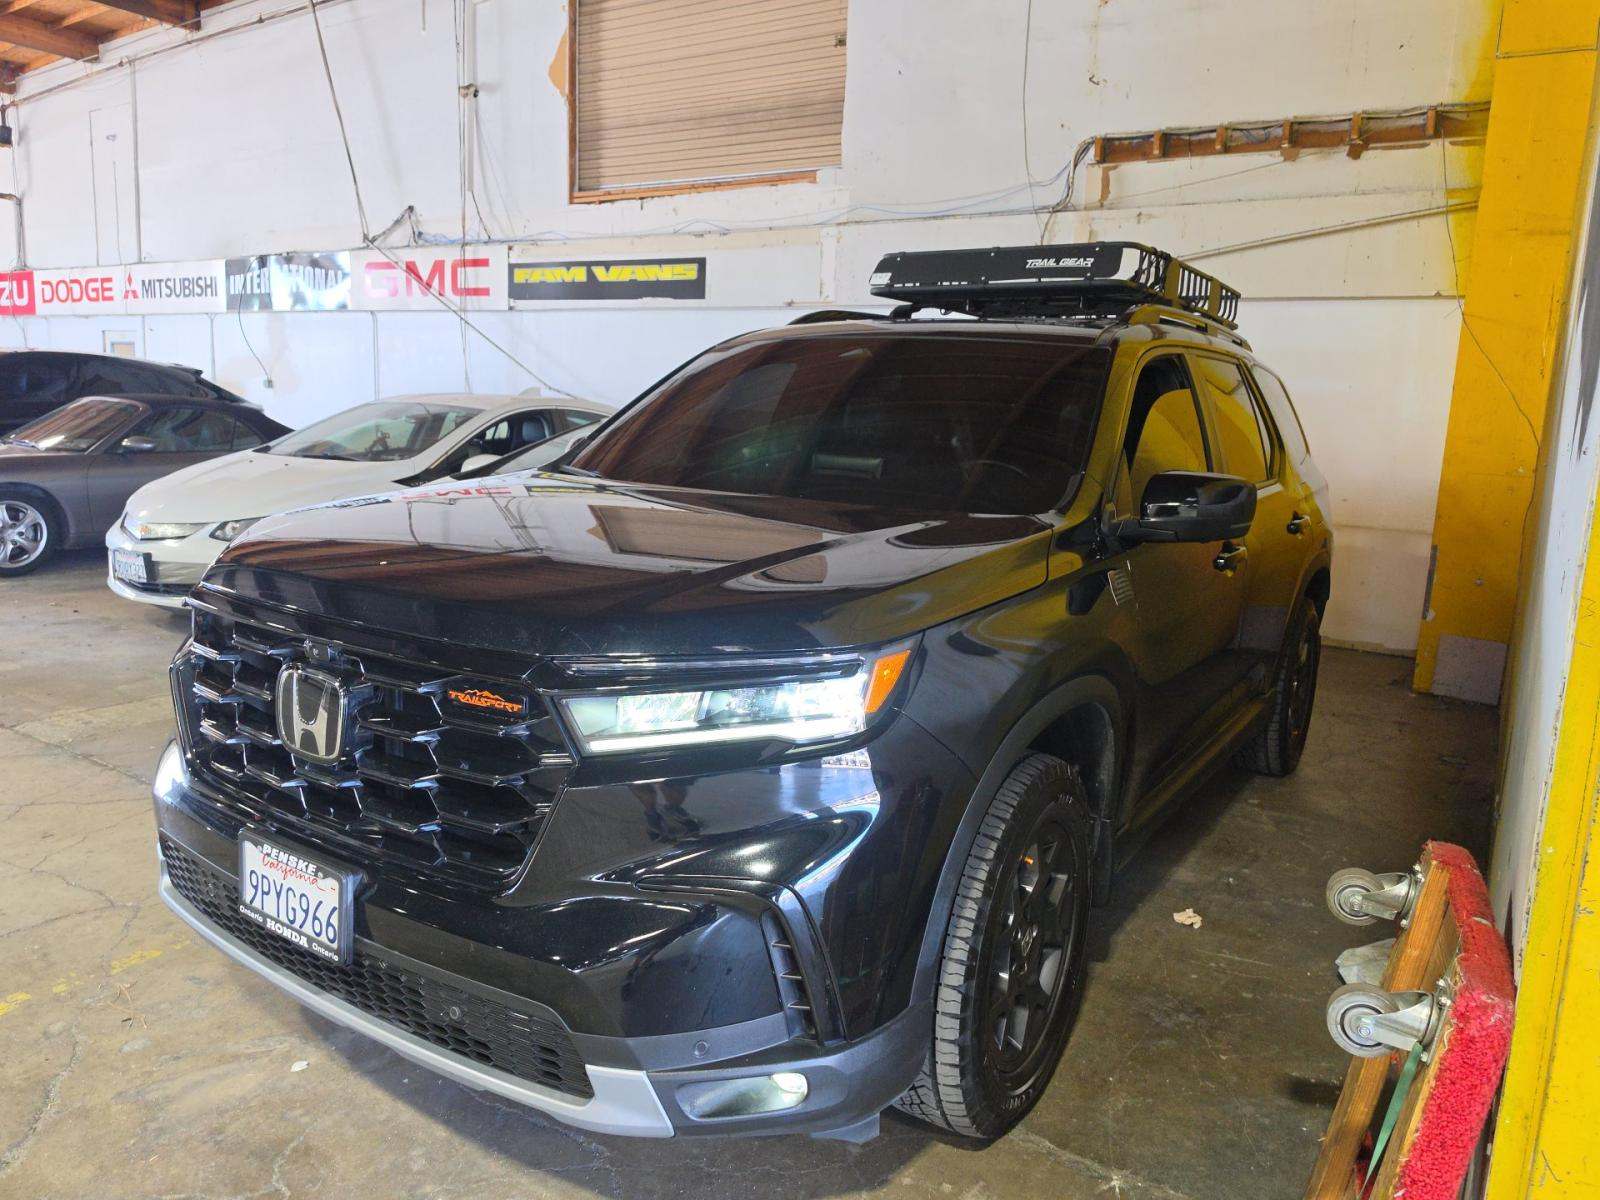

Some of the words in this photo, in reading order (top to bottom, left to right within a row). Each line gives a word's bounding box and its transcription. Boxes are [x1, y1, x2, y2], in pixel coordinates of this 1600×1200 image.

[513, 267, 587, 284] FAM
[590, 263, 698, 282] VANS
[1025, 258, 1057, 269] TRAIL
[1059, 257, 1095, 268] GEAR
[41, 277, 114, 303] DODGE
[141, 278, 218, 299] MITSUBISHI
[364, 257, 490, 298] GMC
[449, 690, 522, 713] TRAILSPORT
[262, 844, 317, 877] PENSKE
[249, 869, 338, 944] 9PYG966
[239, 904, 264, 923] Ontario
[266, 918, 309, 948] HONDA
[311, 942, 339, 962] Ontario
